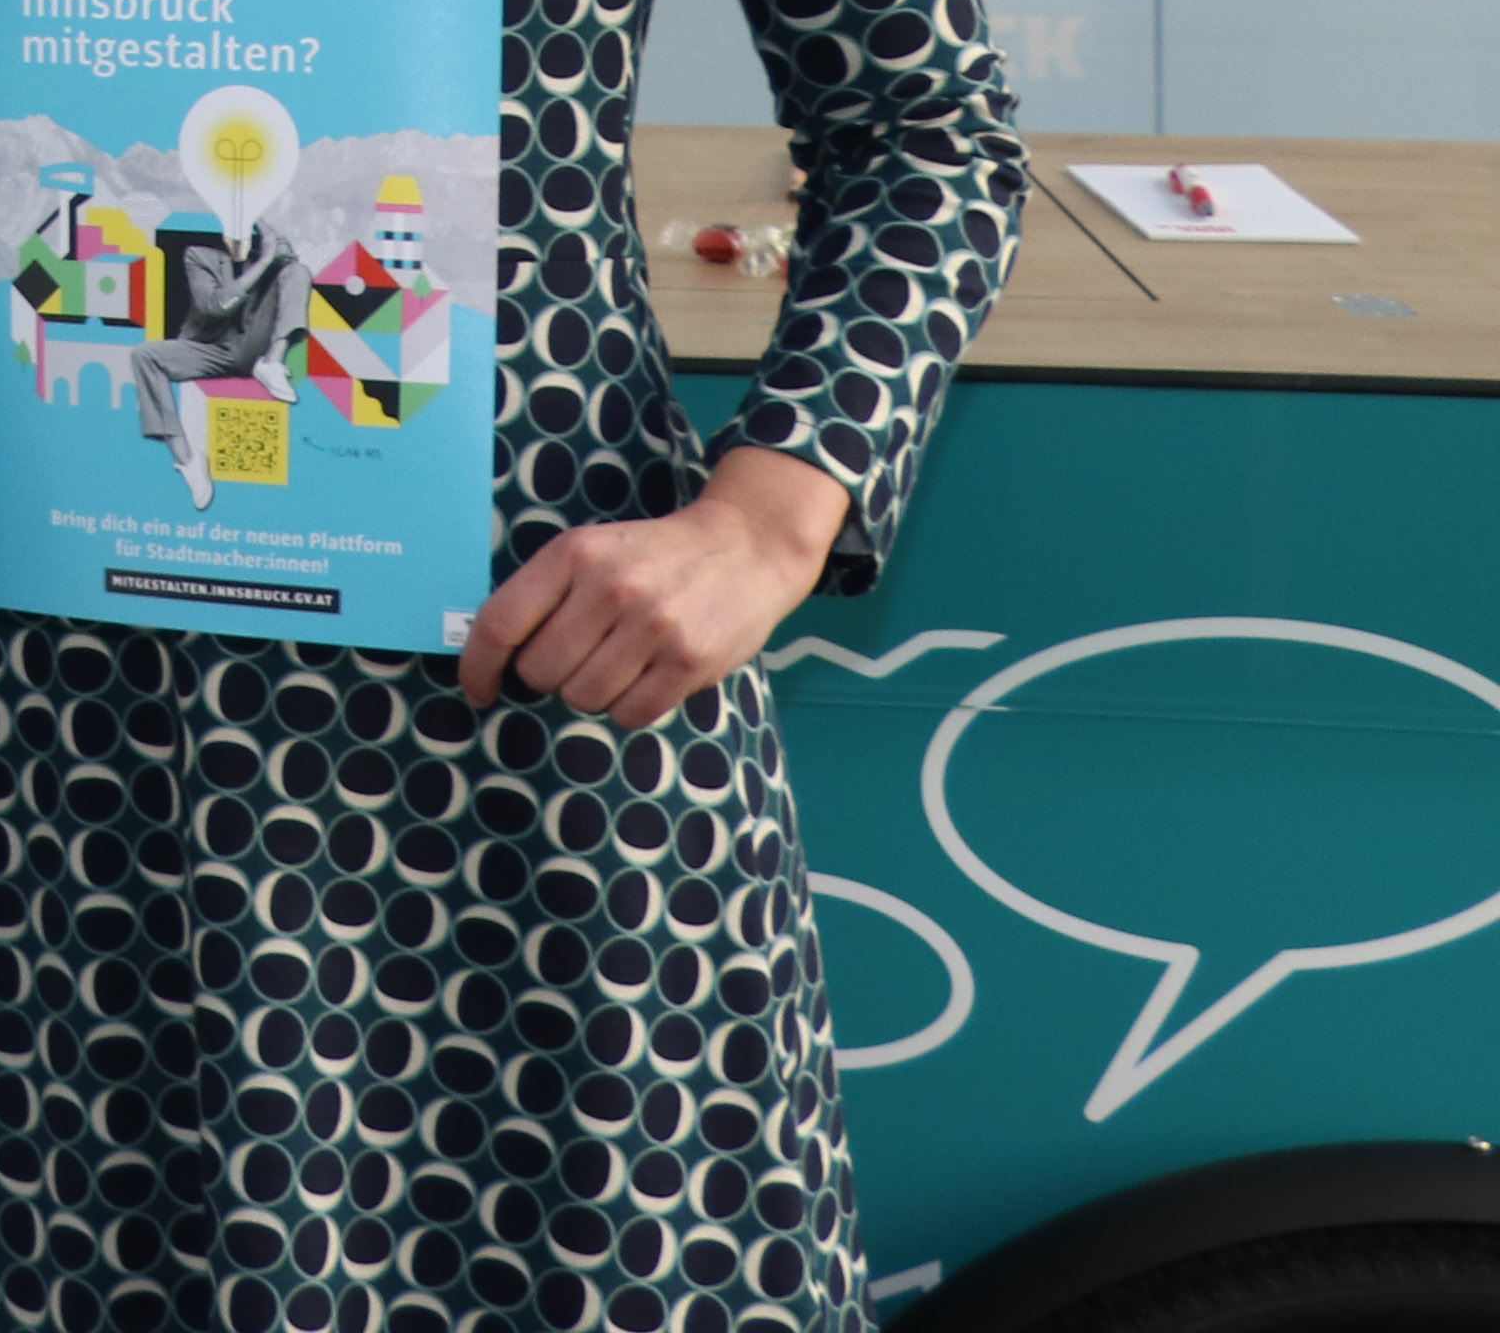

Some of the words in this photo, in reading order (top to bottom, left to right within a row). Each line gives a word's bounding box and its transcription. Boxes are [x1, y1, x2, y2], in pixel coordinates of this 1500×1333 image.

[22, 27, 320, 77] mitgestalten?
[51, 509, 97, 533] Bring
[101, 514, 138, 533] dich
[143, 518, 171, 535] ein
[175, 521, 206, 539] auf
[209, 523, 240, 543] der
[245, 530, 303, 548] neuen
[309, 531, 402, 556] Plattform
[115, 539, 141, 557] für
[147, 542, 329, 574] Stadtmacher:innen!
[111, 574, 334, 607] MITGESTALTEN.INNSBRUCK.GV.AT
